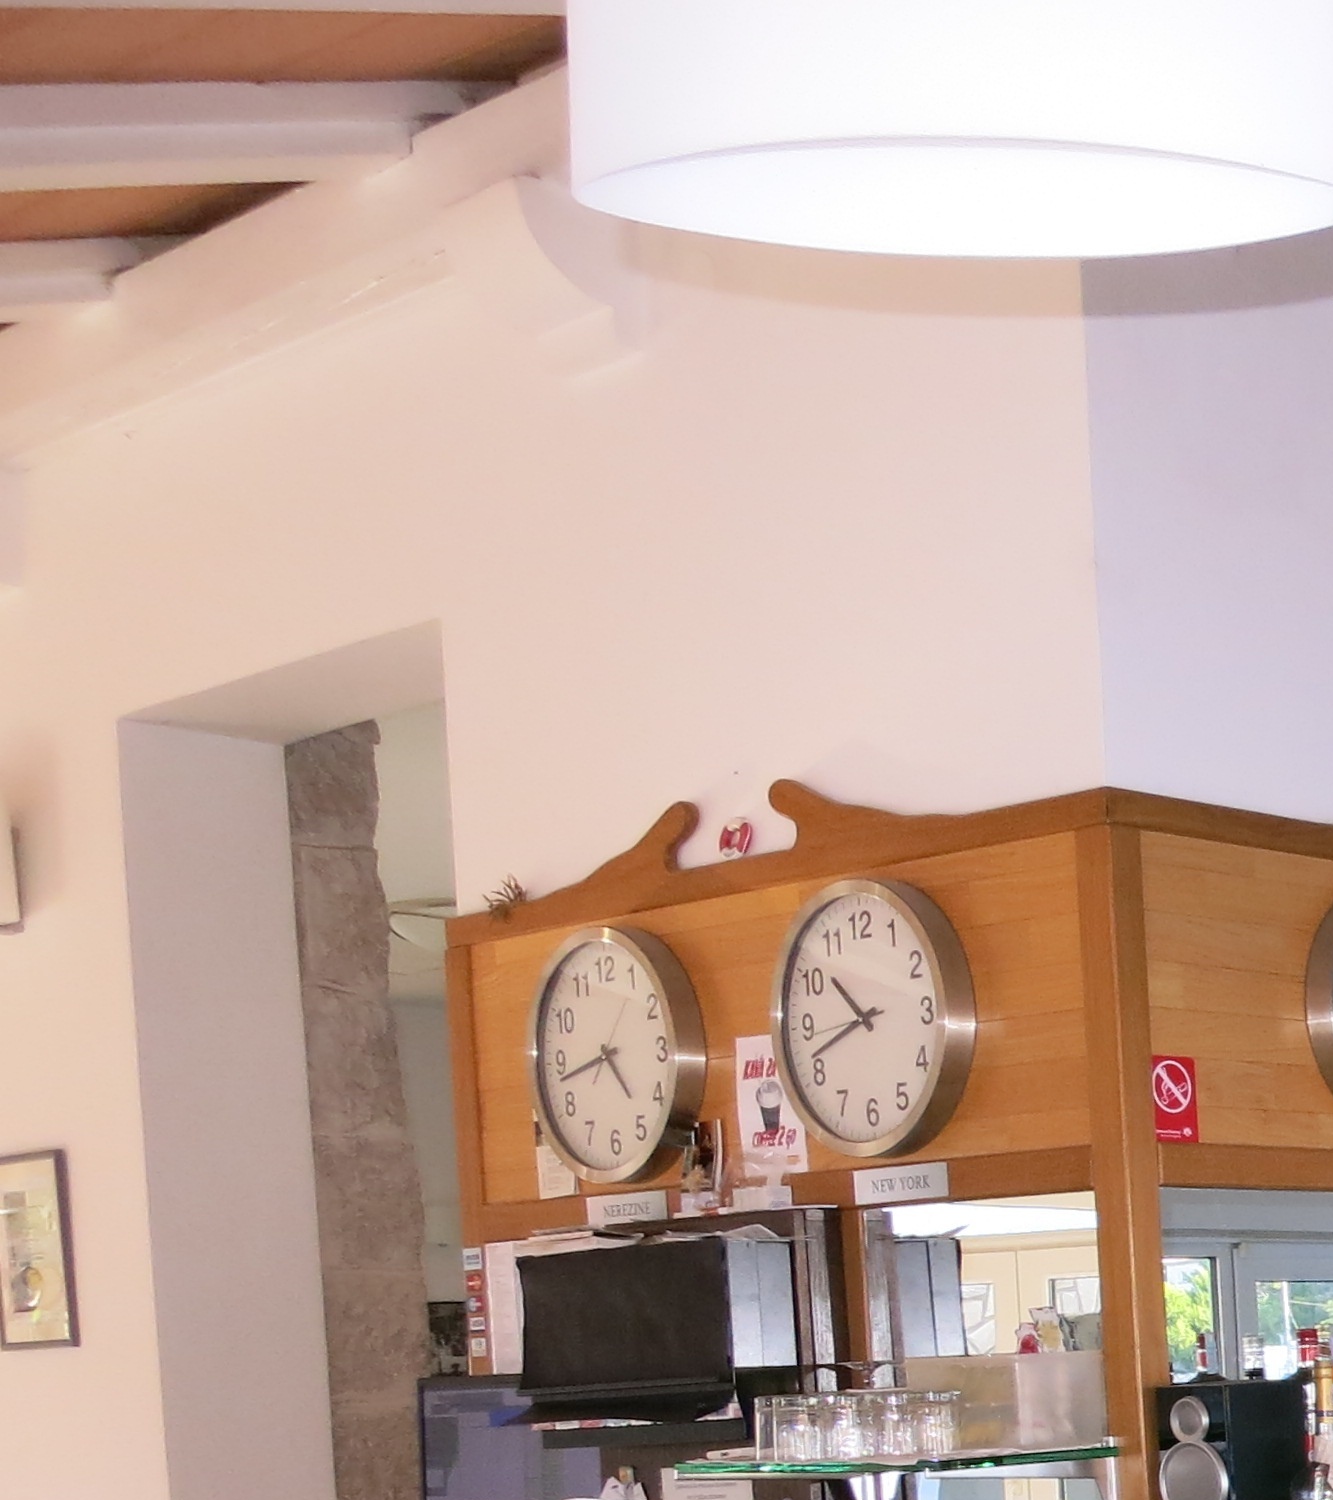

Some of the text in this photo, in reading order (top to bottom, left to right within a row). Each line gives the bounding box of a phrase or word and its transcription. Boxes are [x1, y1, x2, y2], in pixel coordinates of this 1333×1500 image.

[848, 910, 872, 940] 12
[887, 919, 897, 947] 1
[823, 927, 841, 957] 11
[595, 956, 615, 983] 12
[627, 964, 636, 990] 1
[909, 950, 922, 979] 2
[573, 973, 589, 997] 11
[802, 968, 823, 996] 10
[647, 993, 658, 1020] 2
[920, 996, 933, 1025] 3
[556, 1008, 574, 1033] 10
[802, 1013, 814, 1041] 9
[656, 1036, 667, 1062] 3
[916, 1045, 928, 1072] 4
[556, 1050, 566, 1075] 9
[814, 1057, 825, 1086] 8
[565, 1091, 575, 1117] 8
[653, 1081, 664, 1106] 4
[837, 1090, 848, 1116] 7
[897, 1083, 909, 1110] 5
[867, 1098, 879, 1126] 6
[585, 1121, 595, 1146] 7
[636, 1116, 647, 1141] 5
[778, 1125, 785, 1145] 2
[611, 1130, 621, 1155] 6
[871, 1174, 930, 1194] NEW YORK
[603, 1201, 650, 1218] NEREZINE
